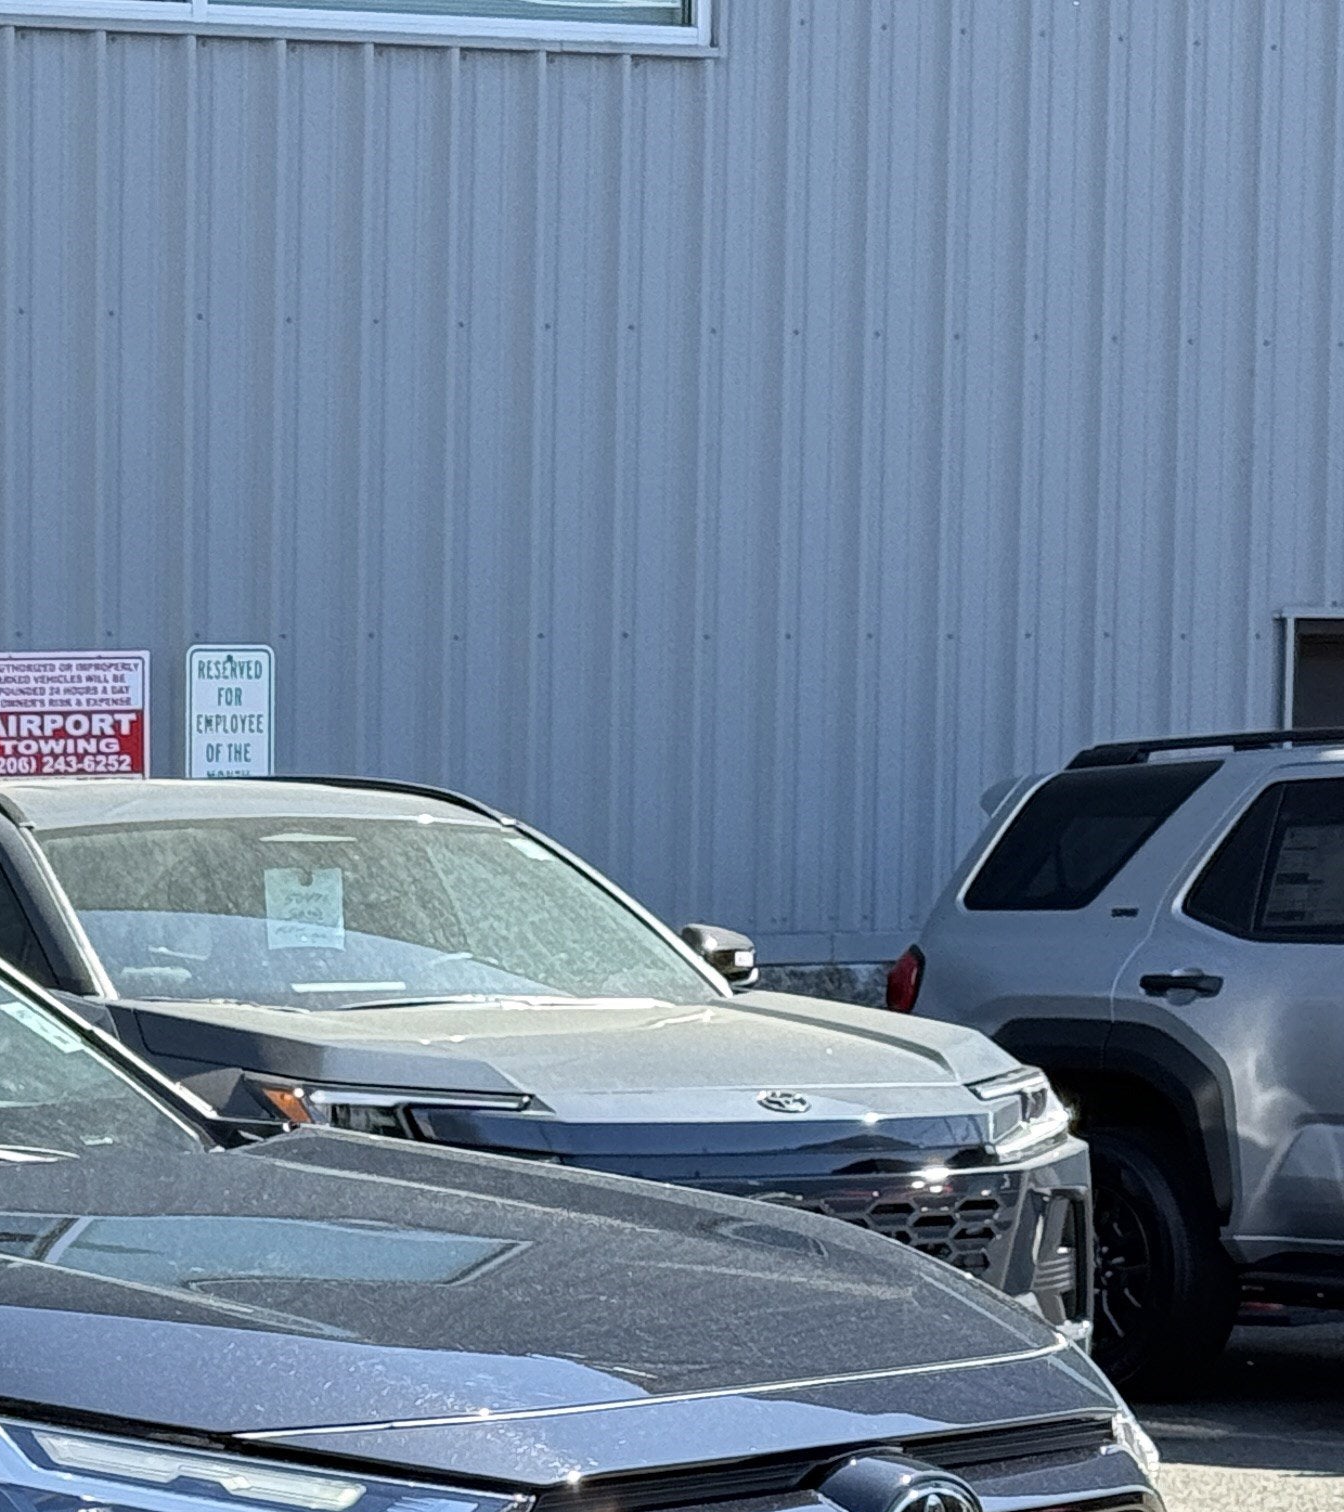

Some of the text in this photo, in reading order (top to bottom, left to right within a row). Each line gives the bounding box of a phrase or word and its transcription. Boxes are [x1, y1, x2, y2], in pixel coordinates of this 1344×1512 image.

[33, 674, 82, 684] VEHICLES
[85, 674, 109, 684] WILL
[113, 673, 126, 683] BE
[198, 660, 263, 680] RESERVED
[101, 685, 108, 695] A
[217, 687, 243, 706] FOR
[196, 714, 264, 734] EMPLOYEE
[206, 743, 252, 763] OF THE
[42, 755, 132, 774] 243-6252
